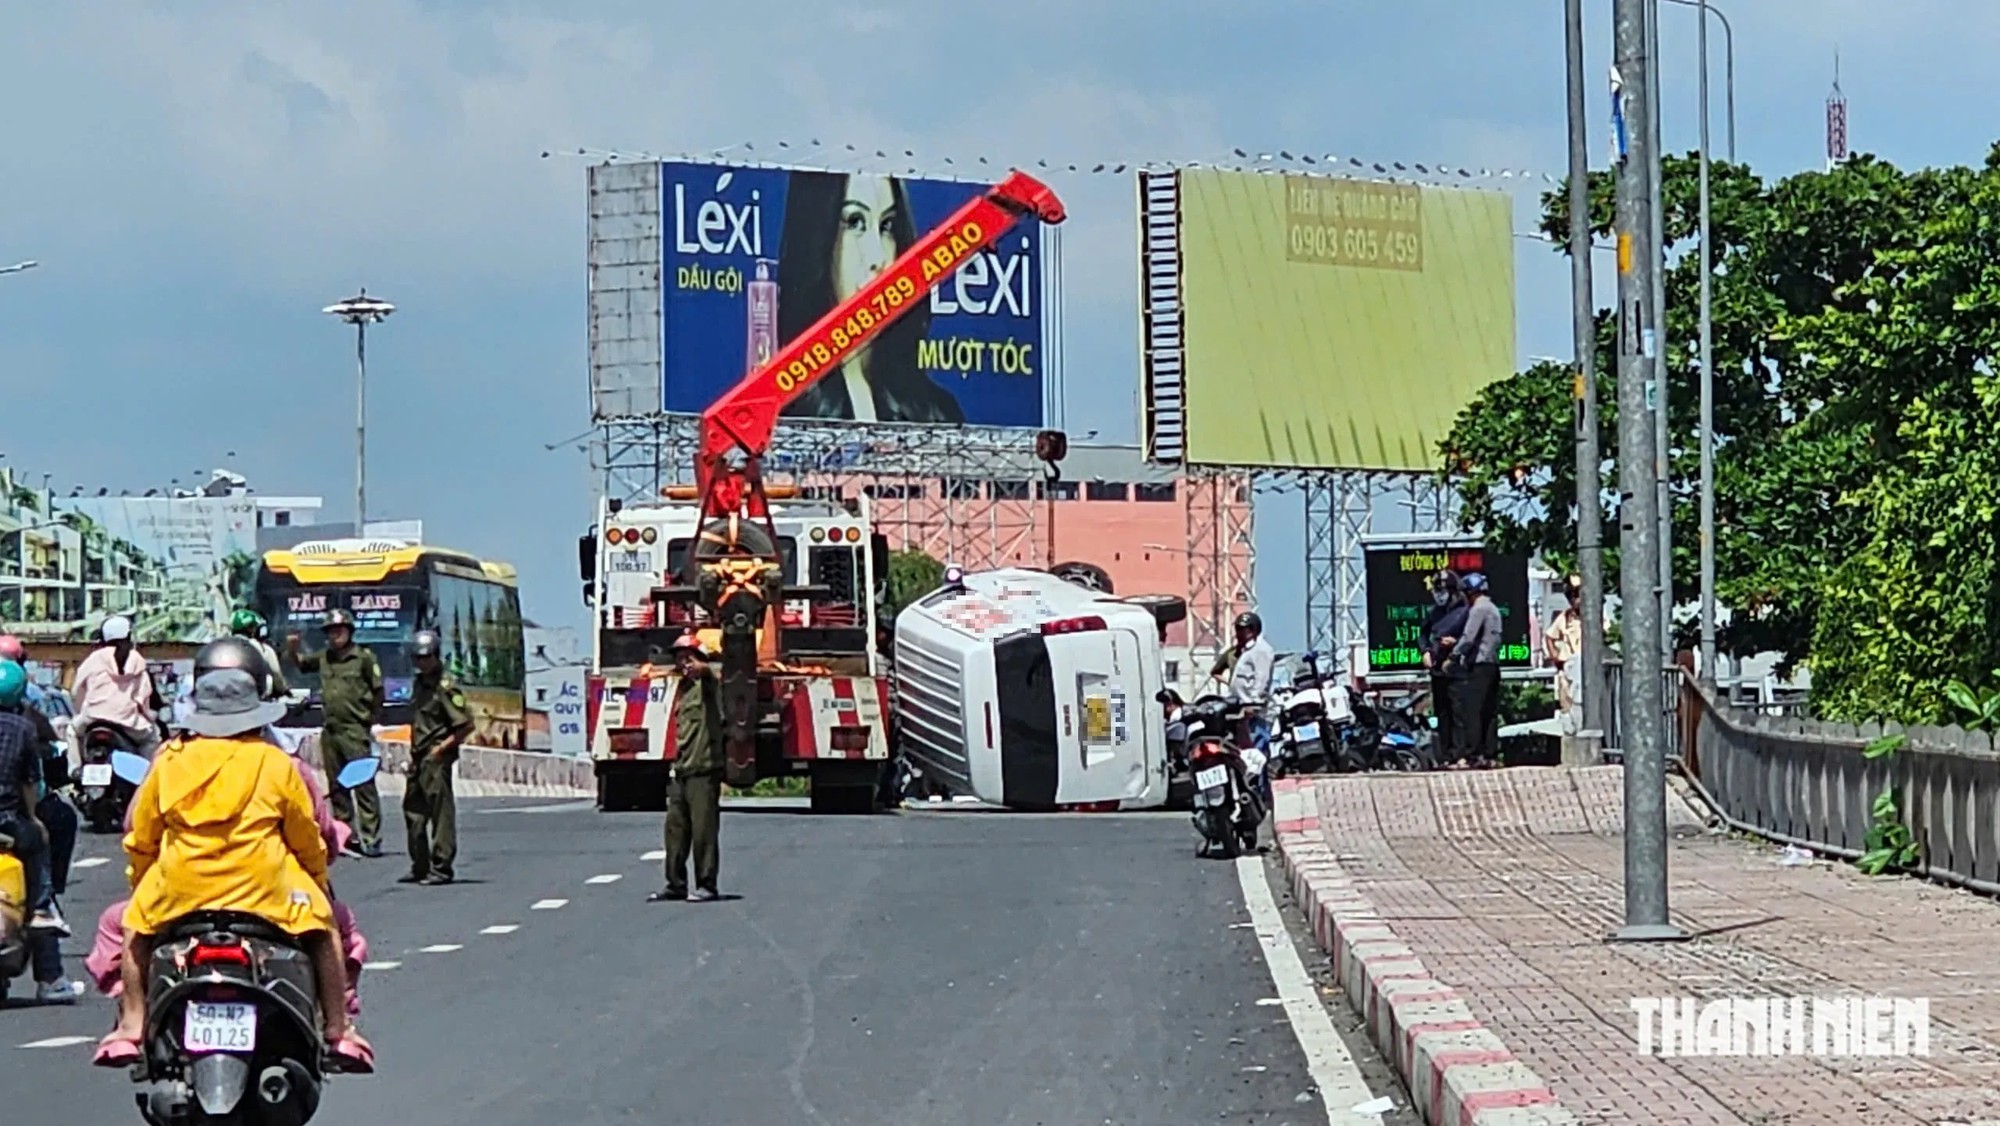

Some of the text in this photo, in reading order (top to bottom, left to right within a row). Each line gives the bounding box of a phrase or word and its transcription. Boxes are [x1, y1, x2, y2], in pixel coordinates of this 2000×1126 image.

[675, 172, 761, 256] Léxi
[1291, 222, 1418, 265] 0903 605 459
[775, 276, 915, 392] 0918.848.789
[917, 336, 1033, 379] MƯỢT TÓC
